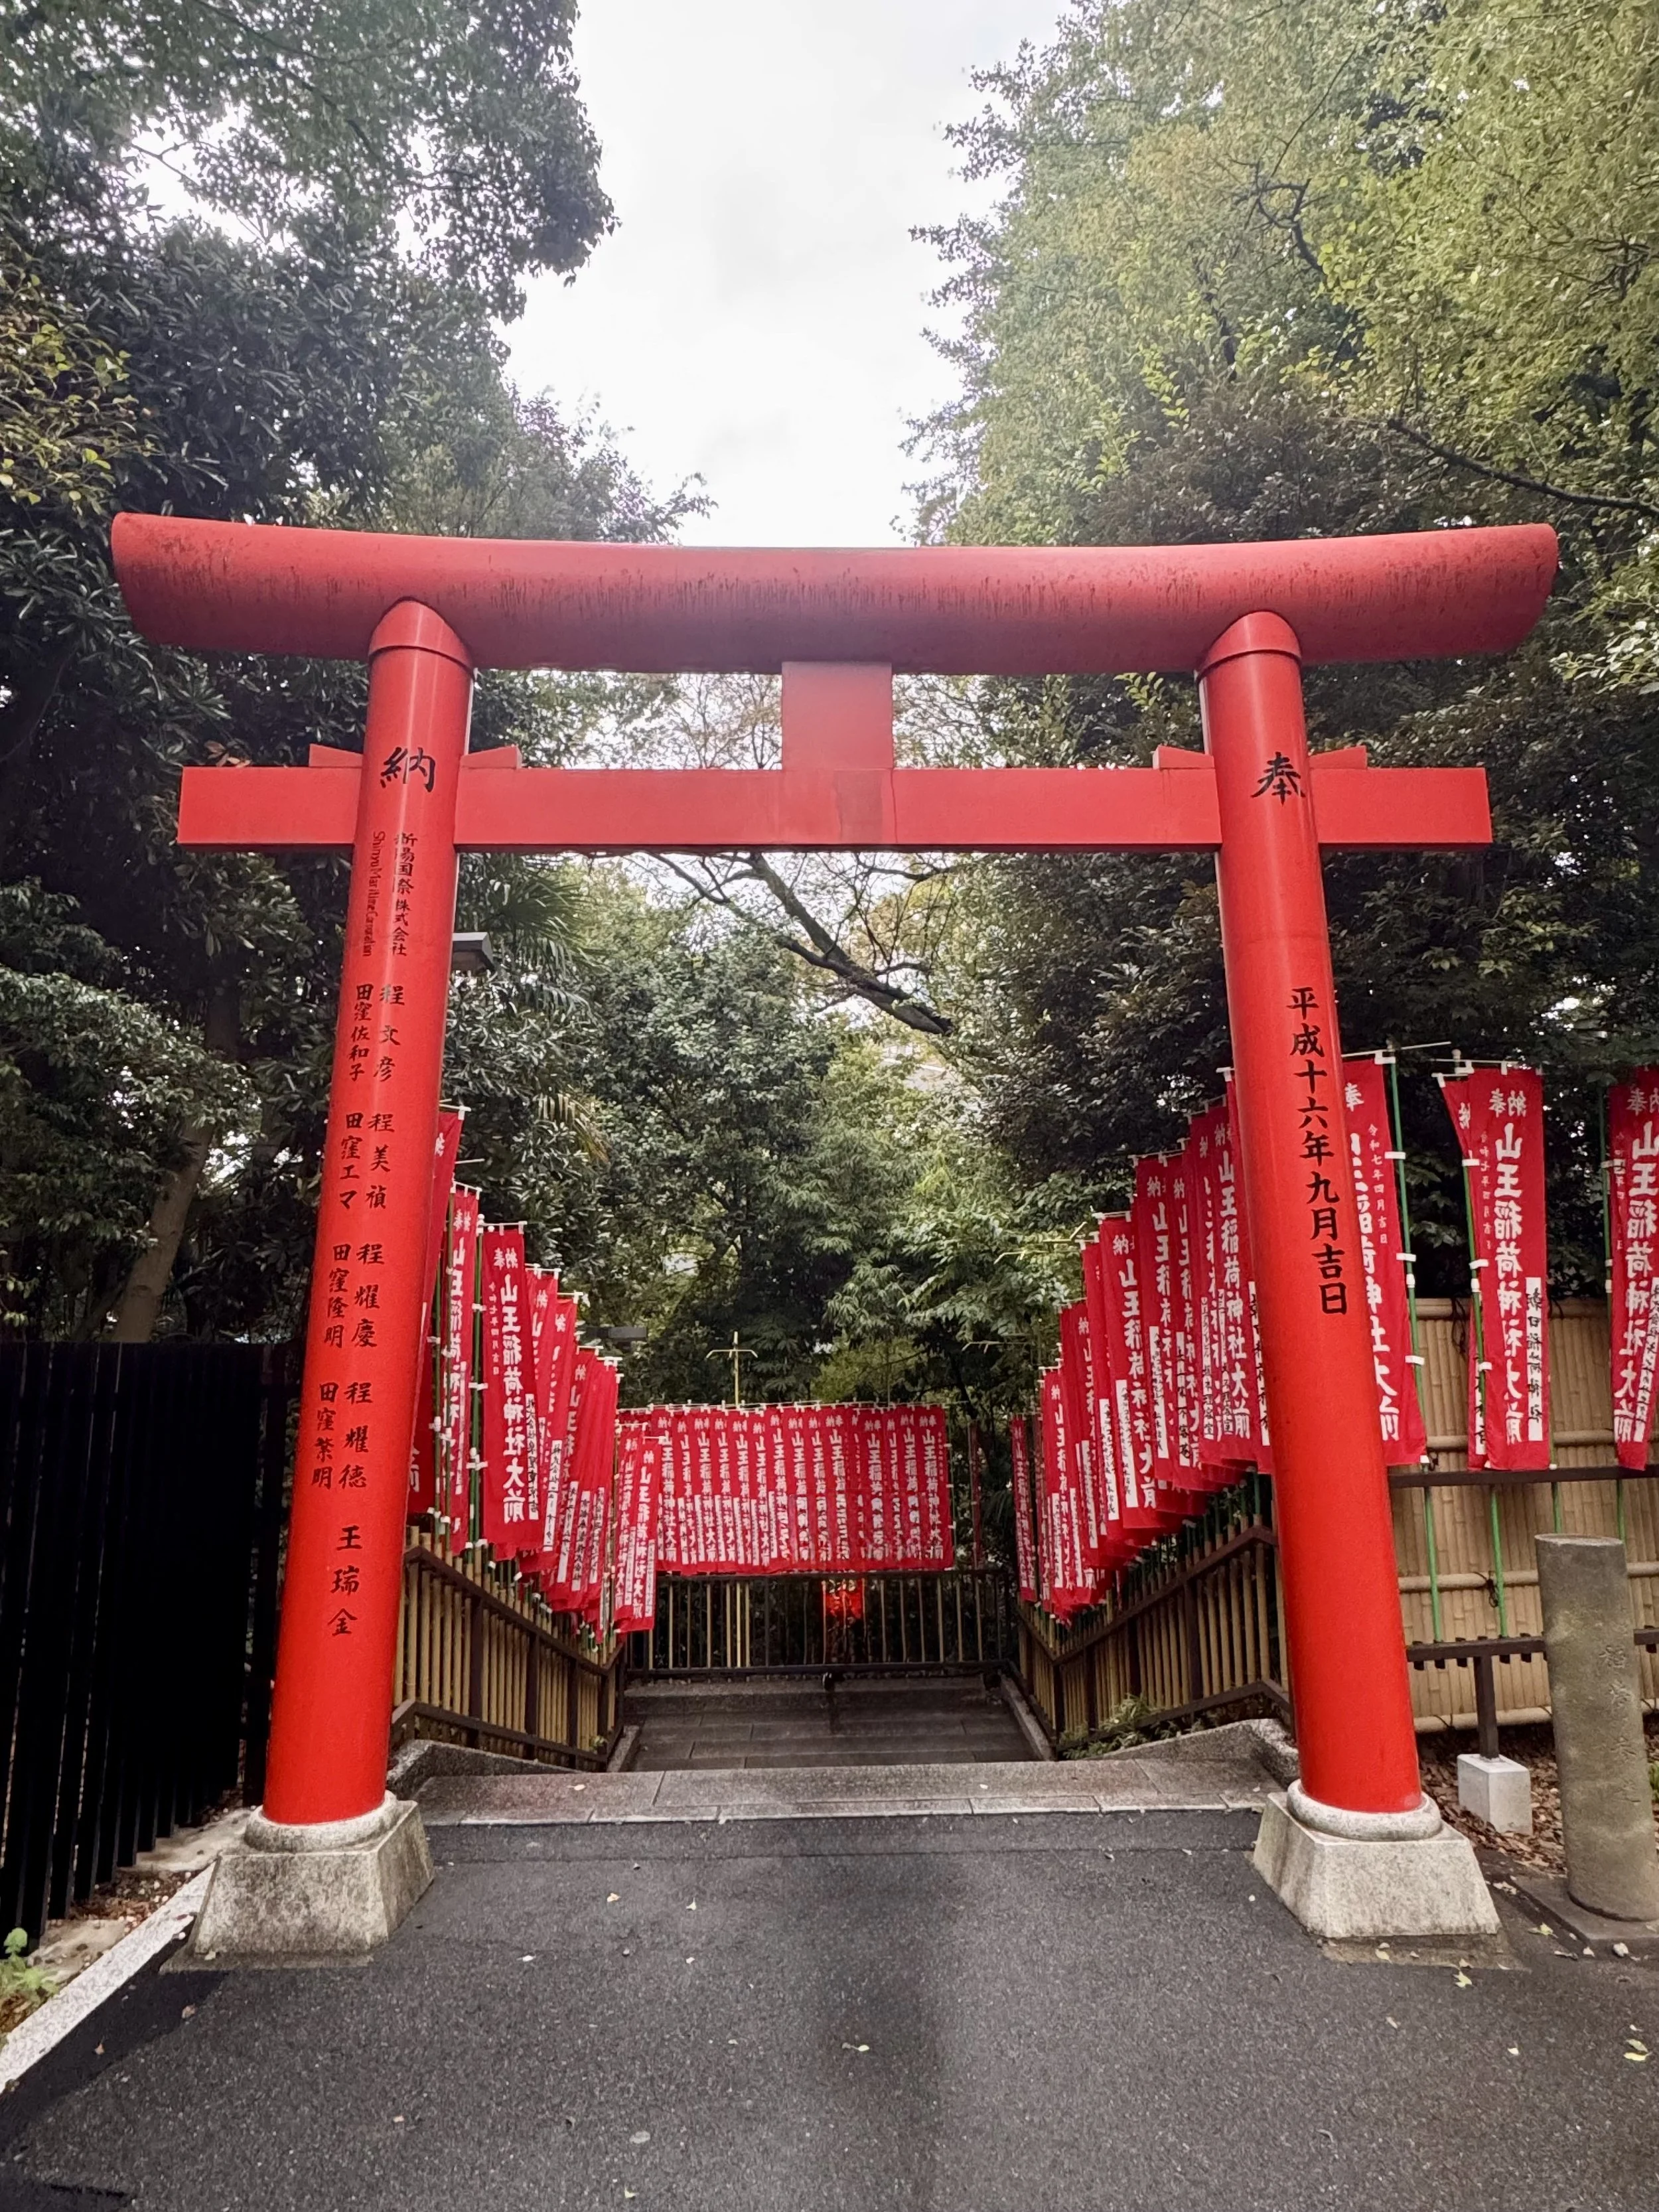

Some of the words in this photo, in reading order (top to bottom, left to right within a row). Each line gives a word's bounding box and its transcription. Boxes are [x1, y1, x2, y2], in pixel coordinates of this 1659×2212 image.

[380, 747, 436, 792] 納
[1250, 751, 1307, 806] 奉
[349, 984, 374, 1082] 田窪佐和子
[1287, 987, 1348, 1316] 平成十六年九月吉日
[1369, 1124, 1388, 1244] 令和七年四月吉日
[324, 1242, 352, 1349] 田窪隆明
[1219, 1150, 1250, 1439] 山王稲荷神社大前
